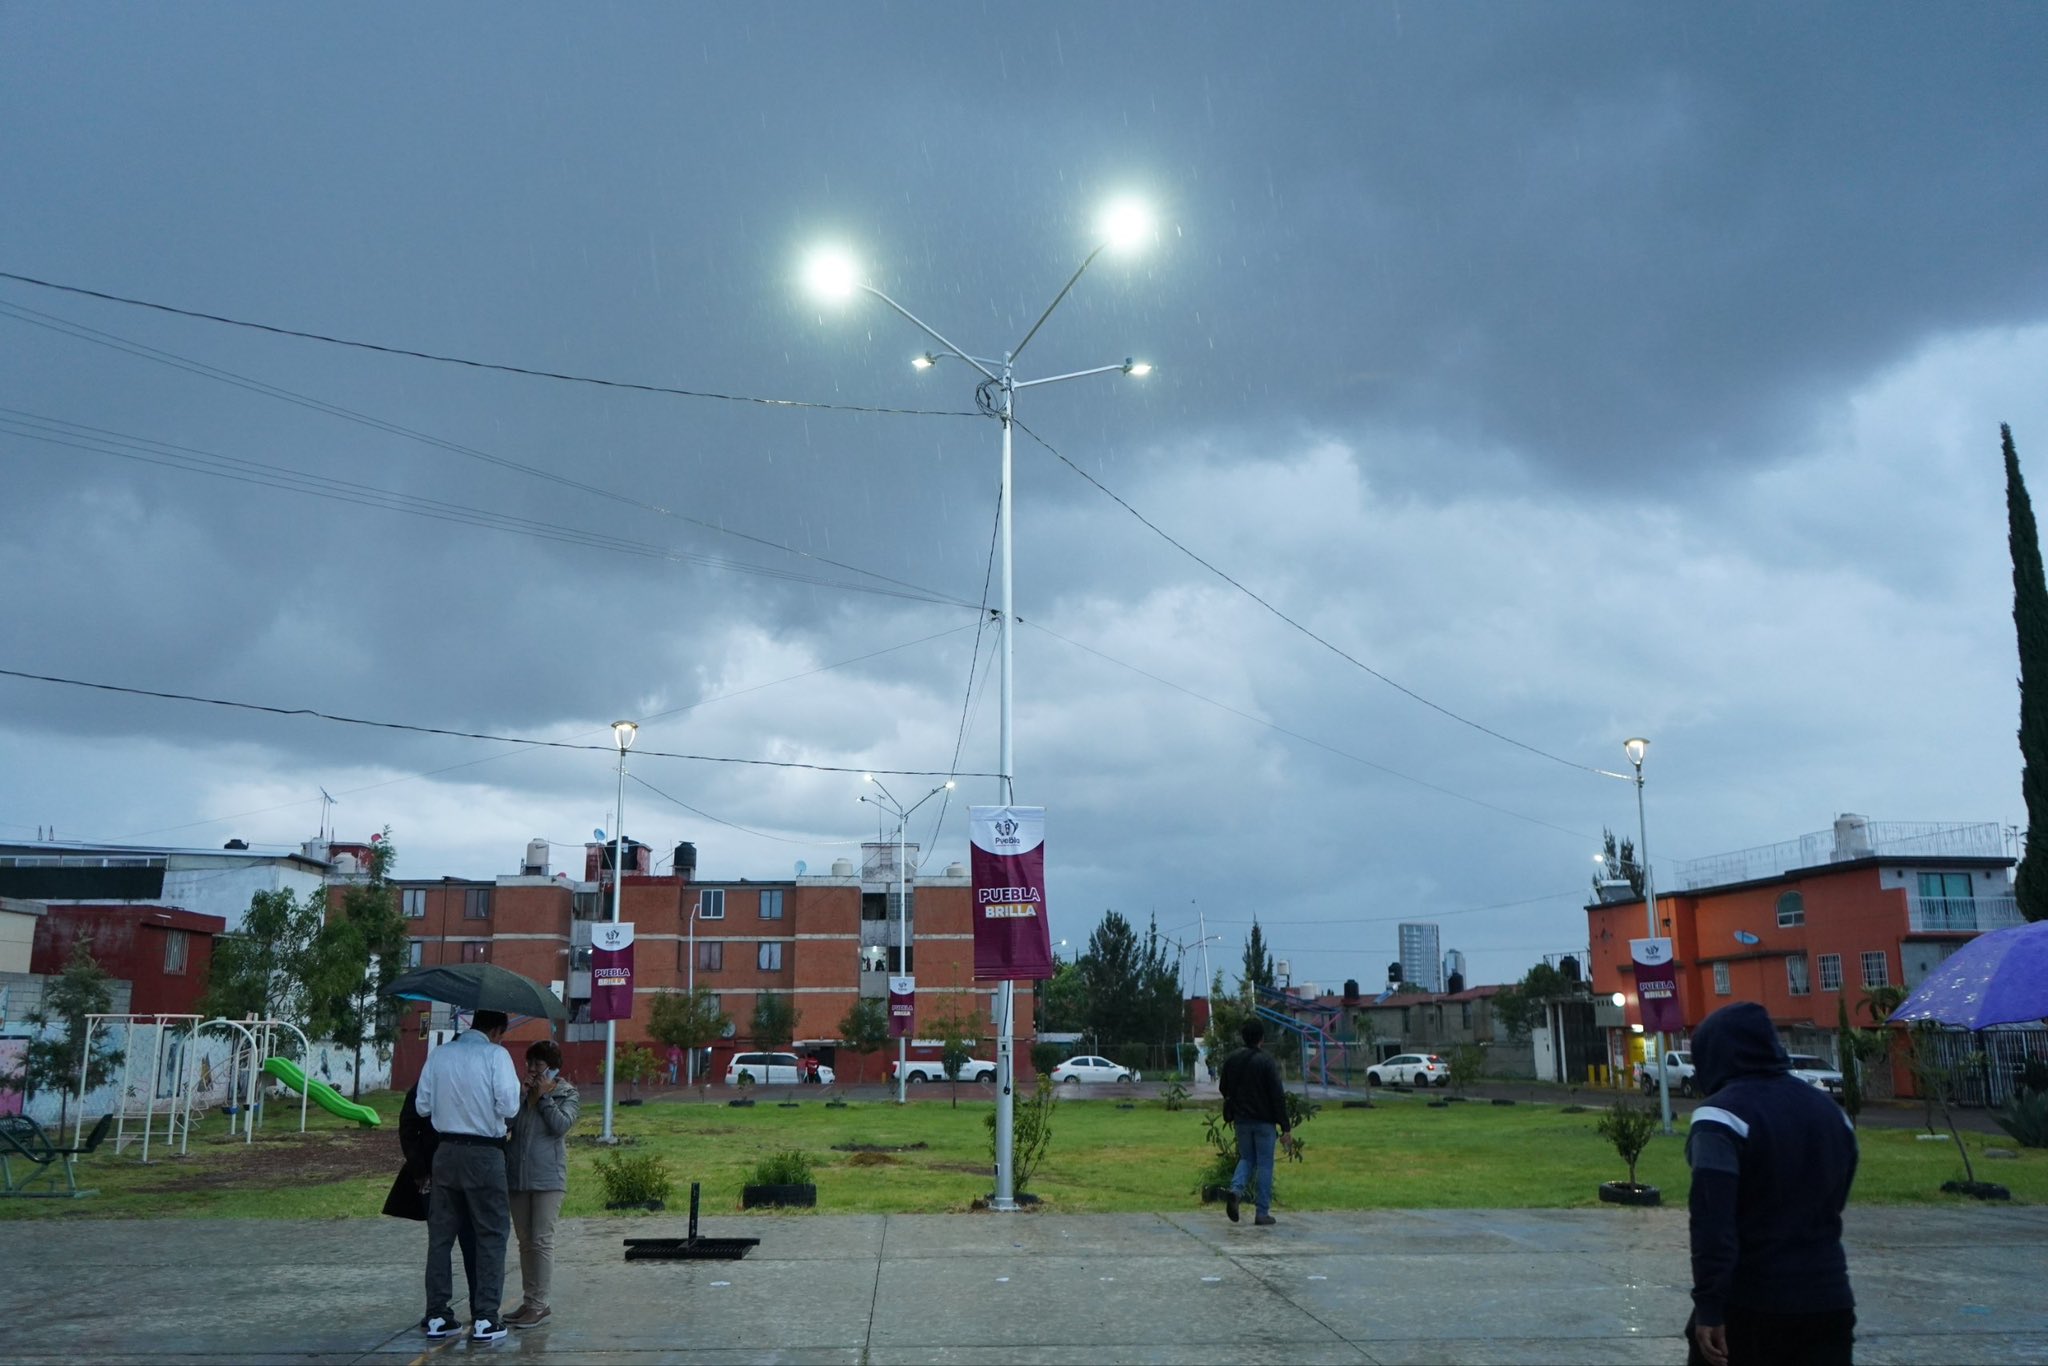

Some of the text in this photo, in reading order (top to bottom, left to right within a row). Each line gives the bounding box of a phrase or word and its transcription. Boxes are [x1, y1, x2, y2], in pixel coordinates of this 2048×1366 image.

[995, 837, 1020, 845] Puebla
[979, 887, 1041, 903] PUEBLA
[985, 904, 1037, 918] BRILLA
[594, 967, 631, 978] PUEBLA
